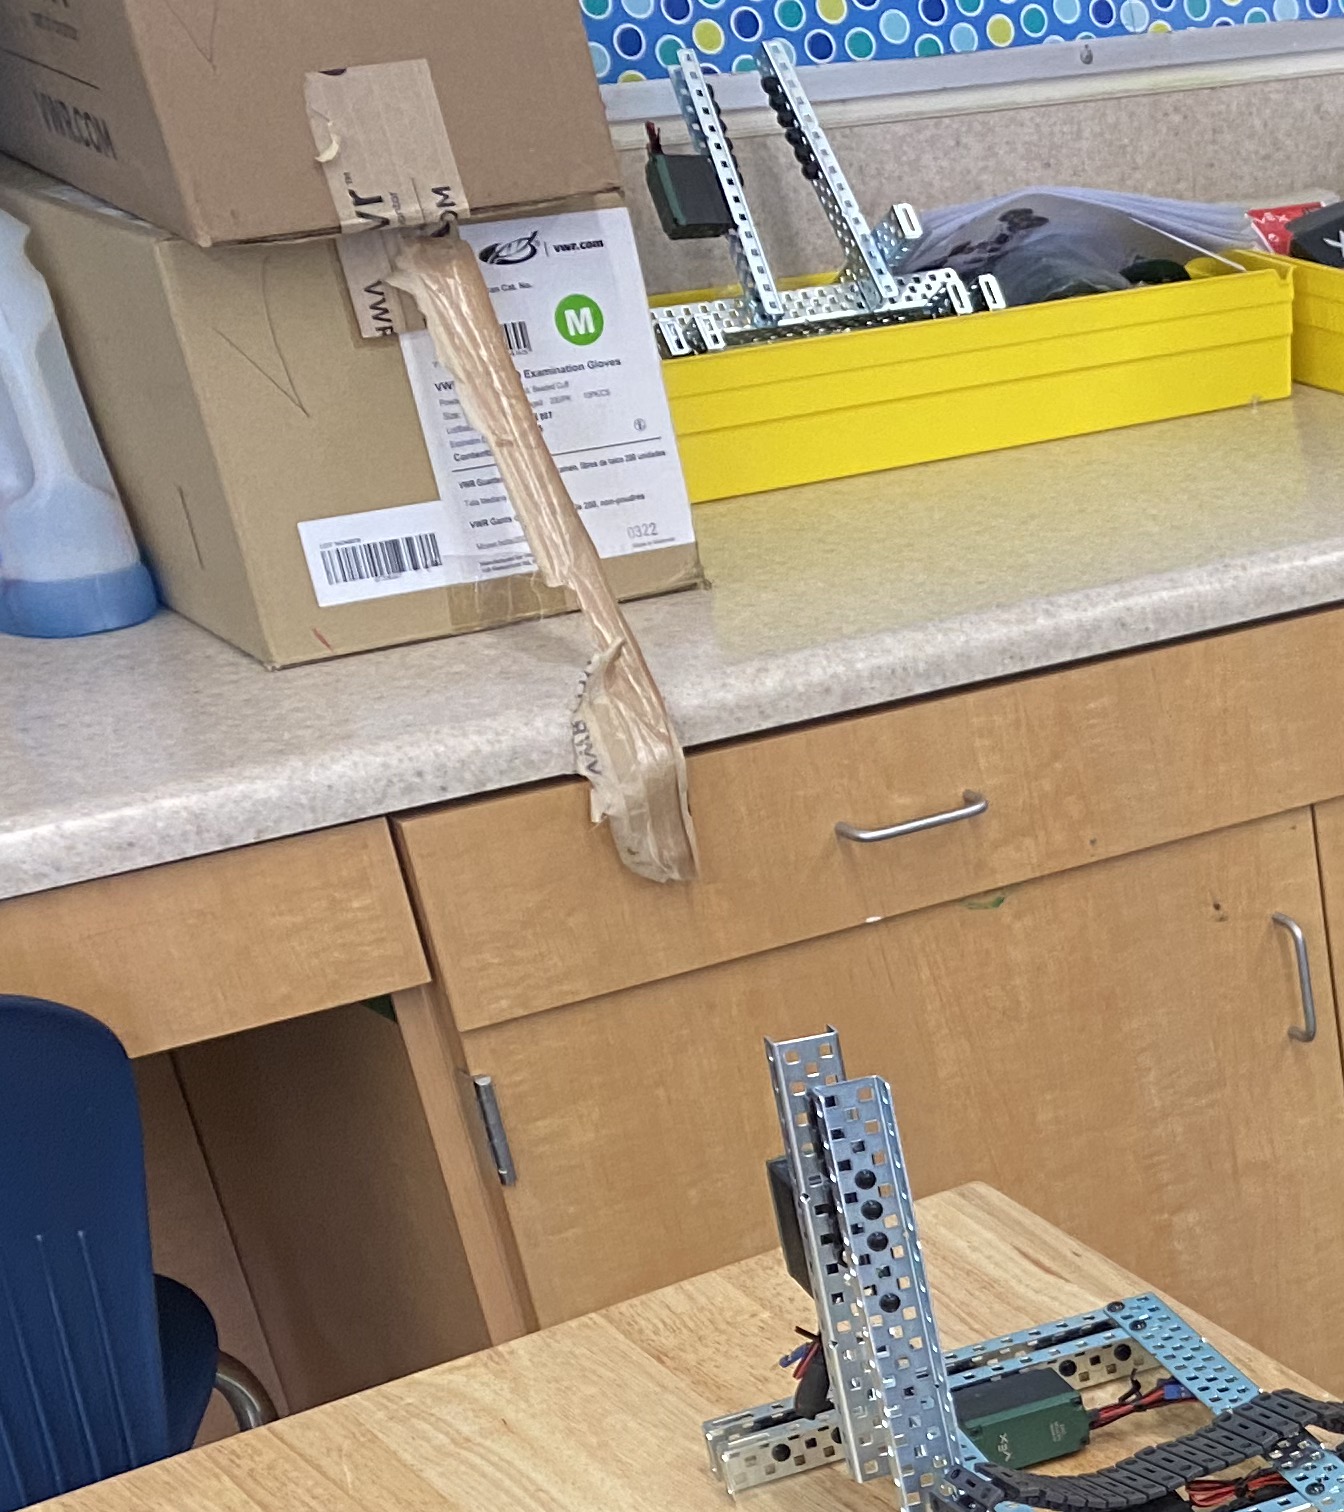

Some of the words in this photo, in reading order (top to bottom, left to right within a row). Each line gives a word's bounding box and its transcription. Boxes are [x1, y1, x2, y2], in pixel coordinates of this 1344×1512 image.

[553, 239, 604, 253] vwr.com
[564, 306, 596, 337] M
[523, 362, 585, 379] Examination
[587, 358, 622, 370] Gloves
[627, 521, 659, 539] 0322
